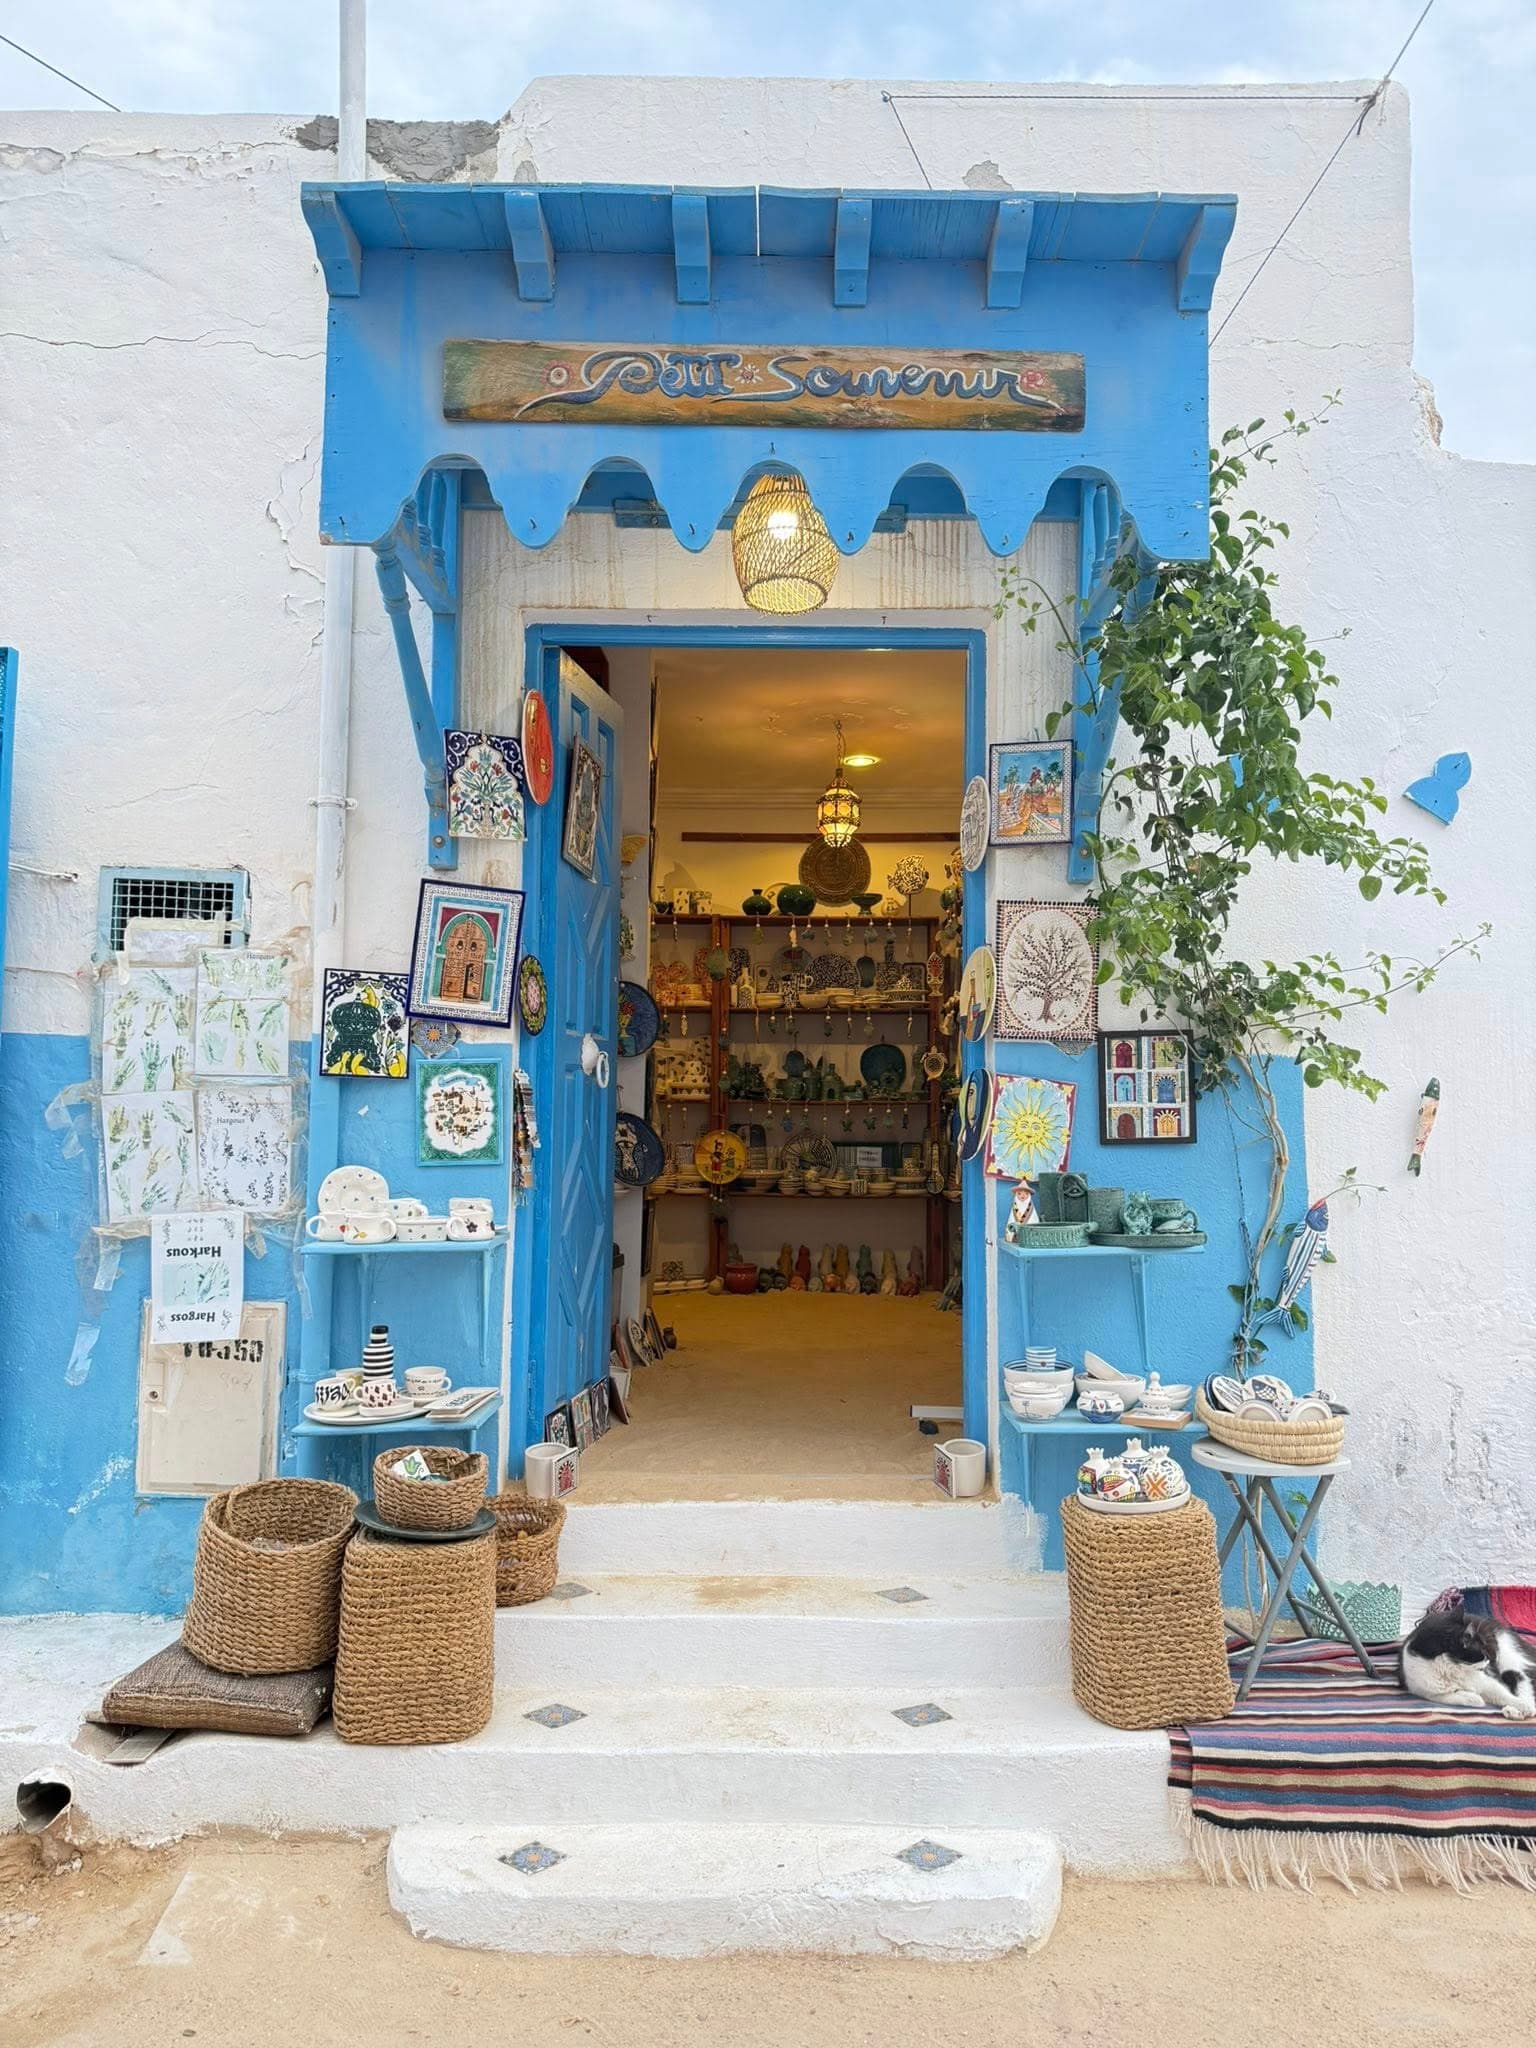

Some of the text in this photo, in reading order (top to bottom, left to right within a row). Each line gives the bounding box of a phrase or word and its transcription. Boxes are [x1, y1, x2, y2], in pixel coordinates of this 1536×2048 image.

[710, 355, 1065, 417] Souvenir
[166, 1246, 222, 1258] Harkous
[170, 1311, 216, 1322] Hargoss
